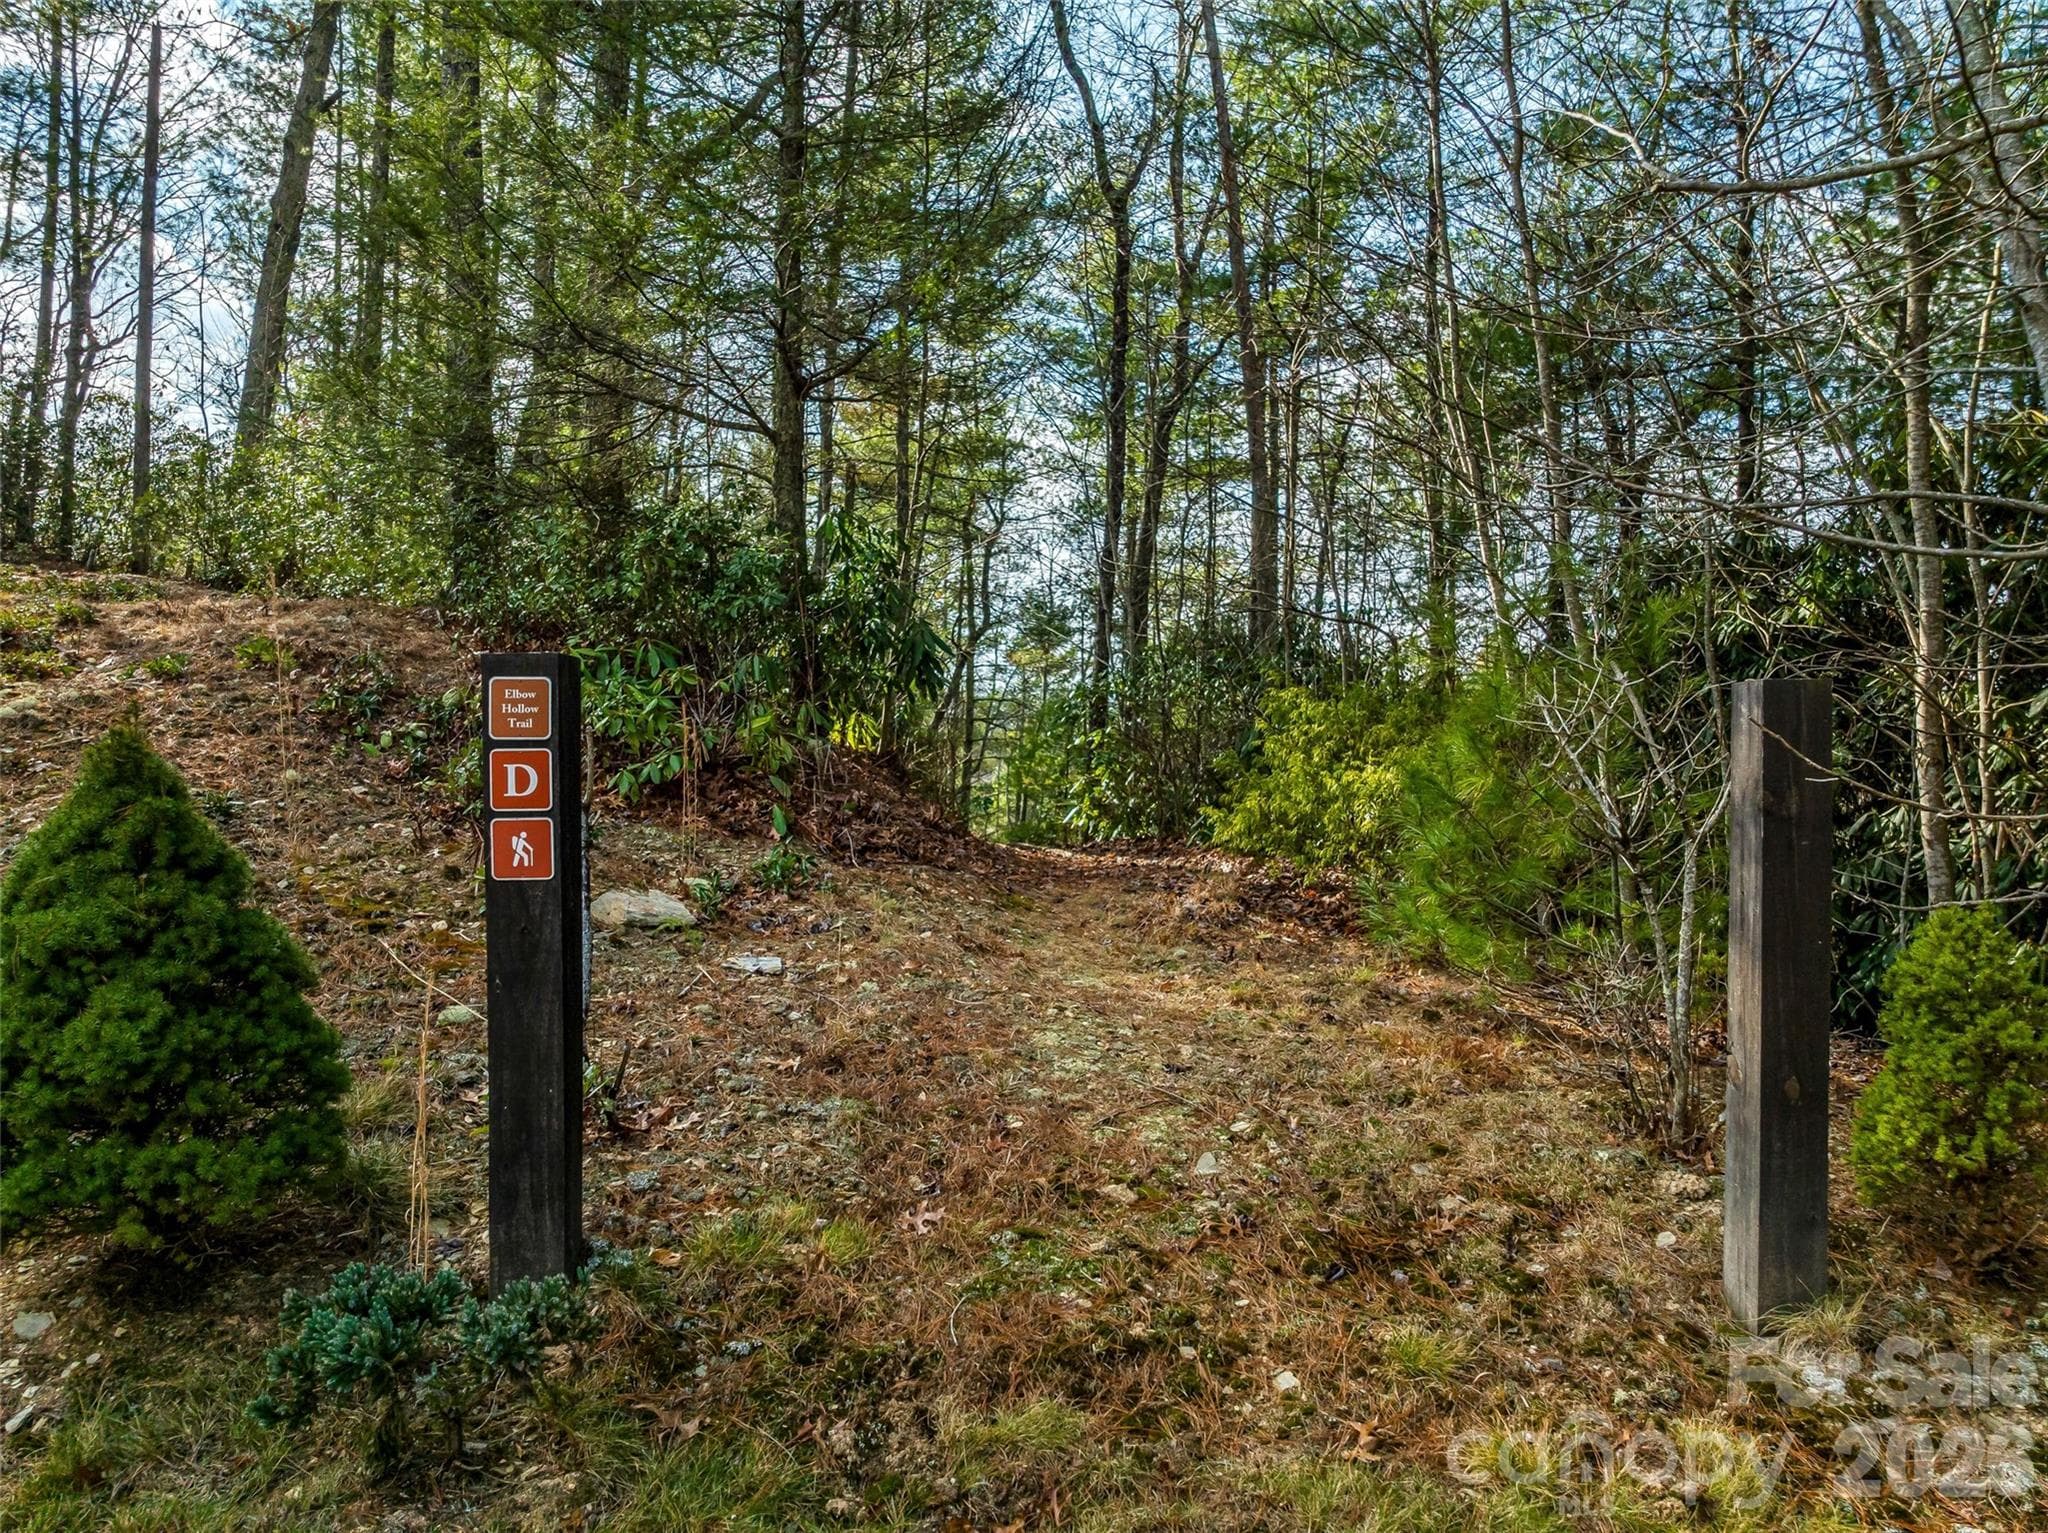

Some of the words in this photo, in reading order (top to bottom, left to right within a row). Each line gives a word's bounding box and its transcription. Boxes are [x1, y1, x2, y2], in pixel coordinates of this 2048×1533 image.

[504, 688, 537, 700] Elbow
[501, 703, 539, 715] Hollow
[507, 717, 533, 729] Trail
[503, 763, 539, 798] D
